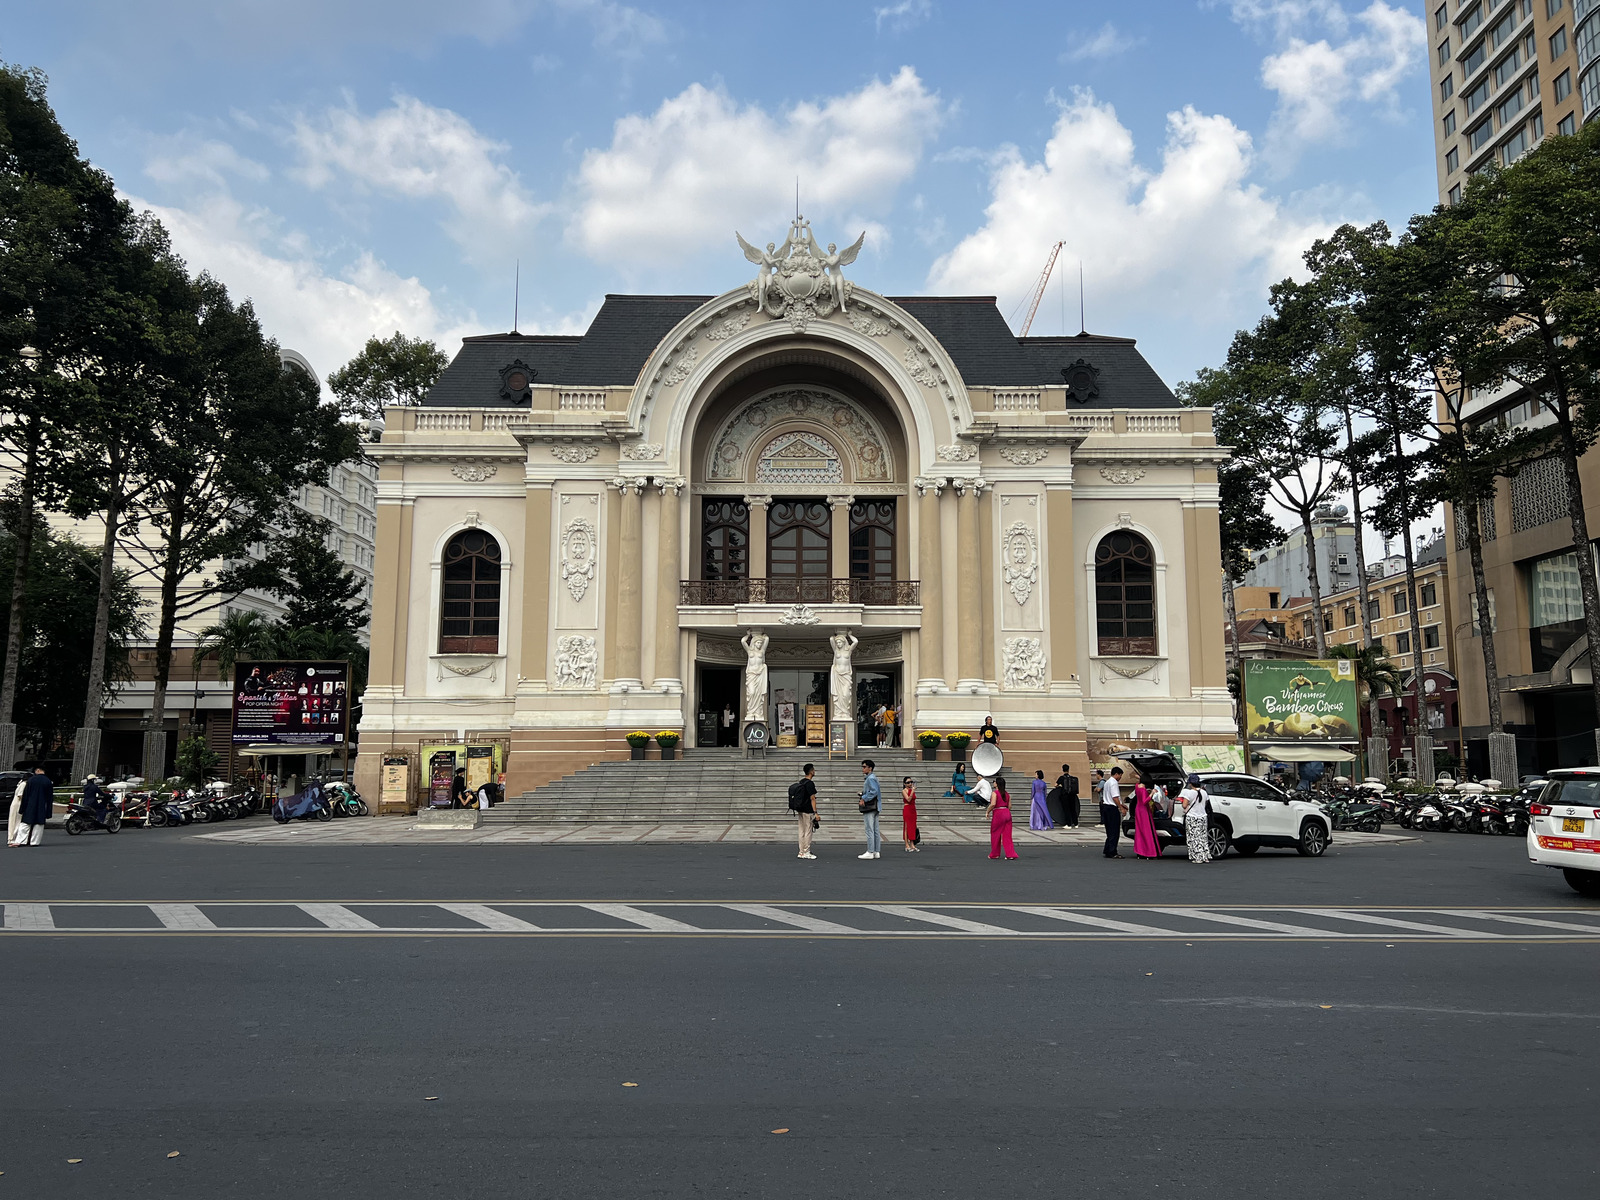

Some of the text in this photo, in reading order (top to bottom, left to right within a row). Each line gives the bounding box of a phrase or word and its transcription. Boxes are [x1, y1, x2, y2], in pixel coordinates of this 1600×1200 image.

[237, 692, 267, 704] Spanish
[272, 692, 298, 702] Italian
[1280, 688, 1326, 700] Vietnamese
[1262, 695, 1344, 714] Bamboo Circus
